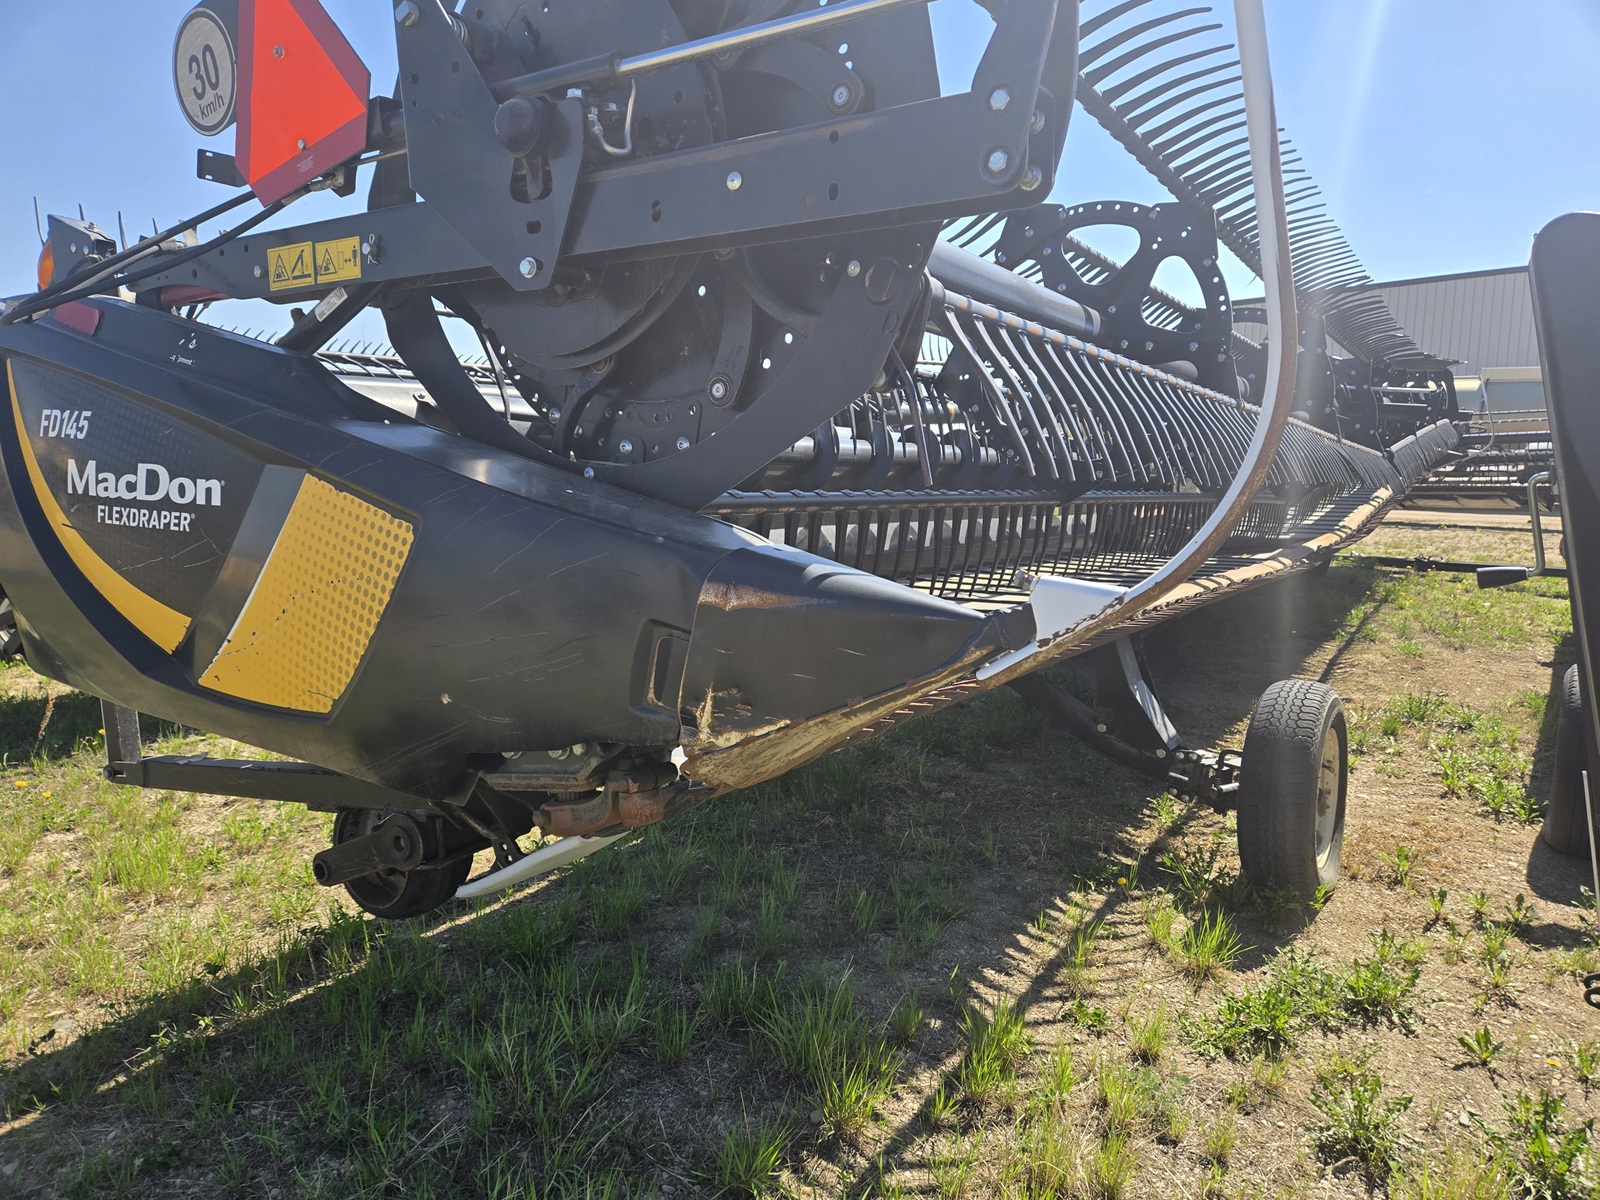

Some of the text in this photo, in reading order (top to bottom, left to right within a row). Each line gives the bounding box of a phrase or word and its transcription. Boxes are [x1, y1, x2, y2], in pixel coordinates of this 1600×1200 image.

[188, 43, 220, 101] 30
[199, 92, 225, 120] km/h
[39, 409, 92, 440] FD145
